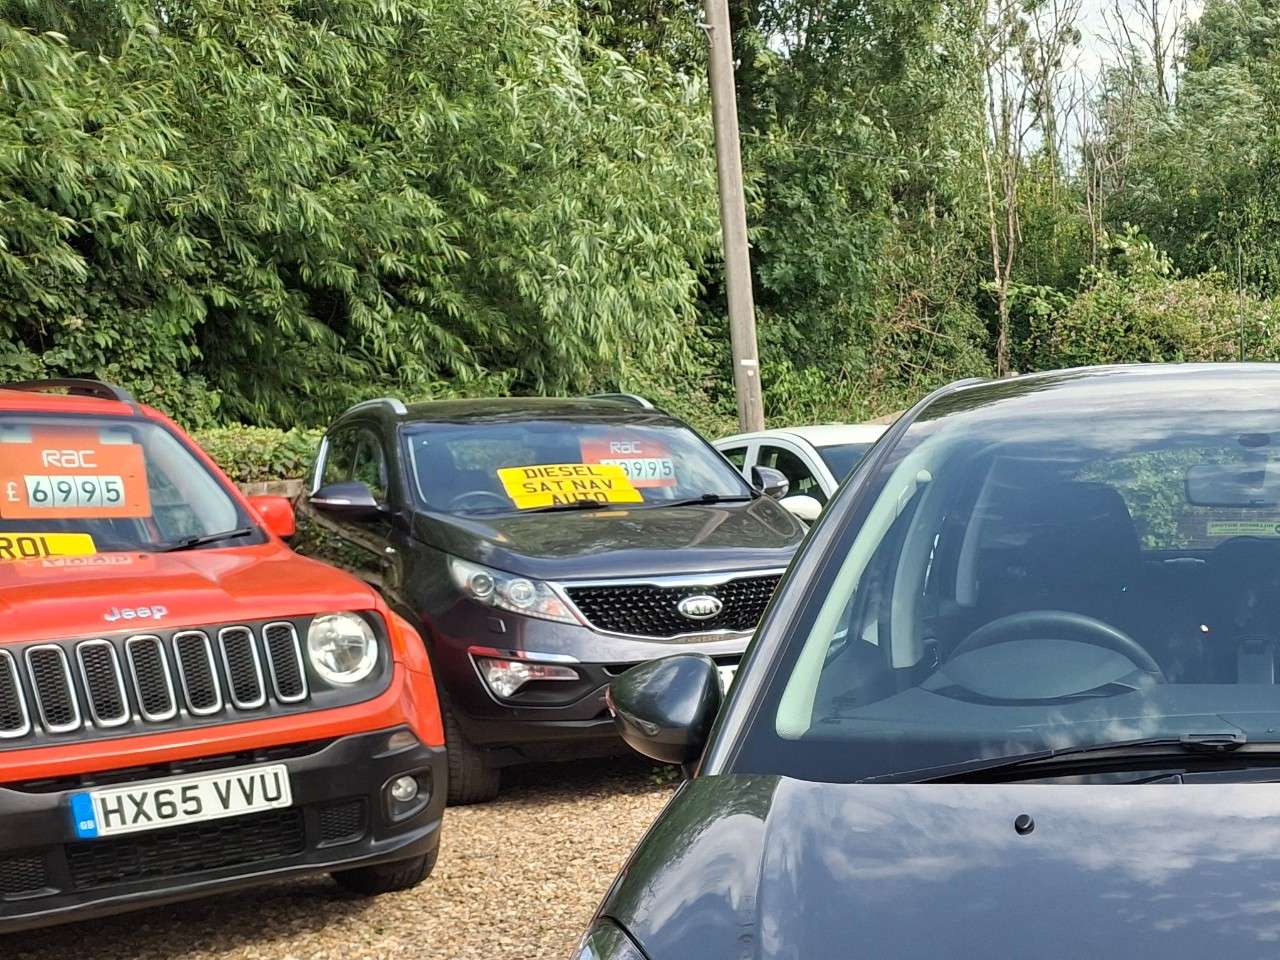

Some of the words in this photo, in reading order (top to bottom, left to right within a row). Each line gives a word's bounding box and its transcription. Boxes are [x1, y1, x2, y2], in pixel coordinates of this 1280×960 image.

[523, 466, 601, 479] DIESEL
[523, 480, 564, 493] SAT
[573, 479, 613, 491] NAV
[104, 605, 169, 621] Jeep
[99, 784, 203, 828] HX65
[212, 771, 283, 811] VVU
